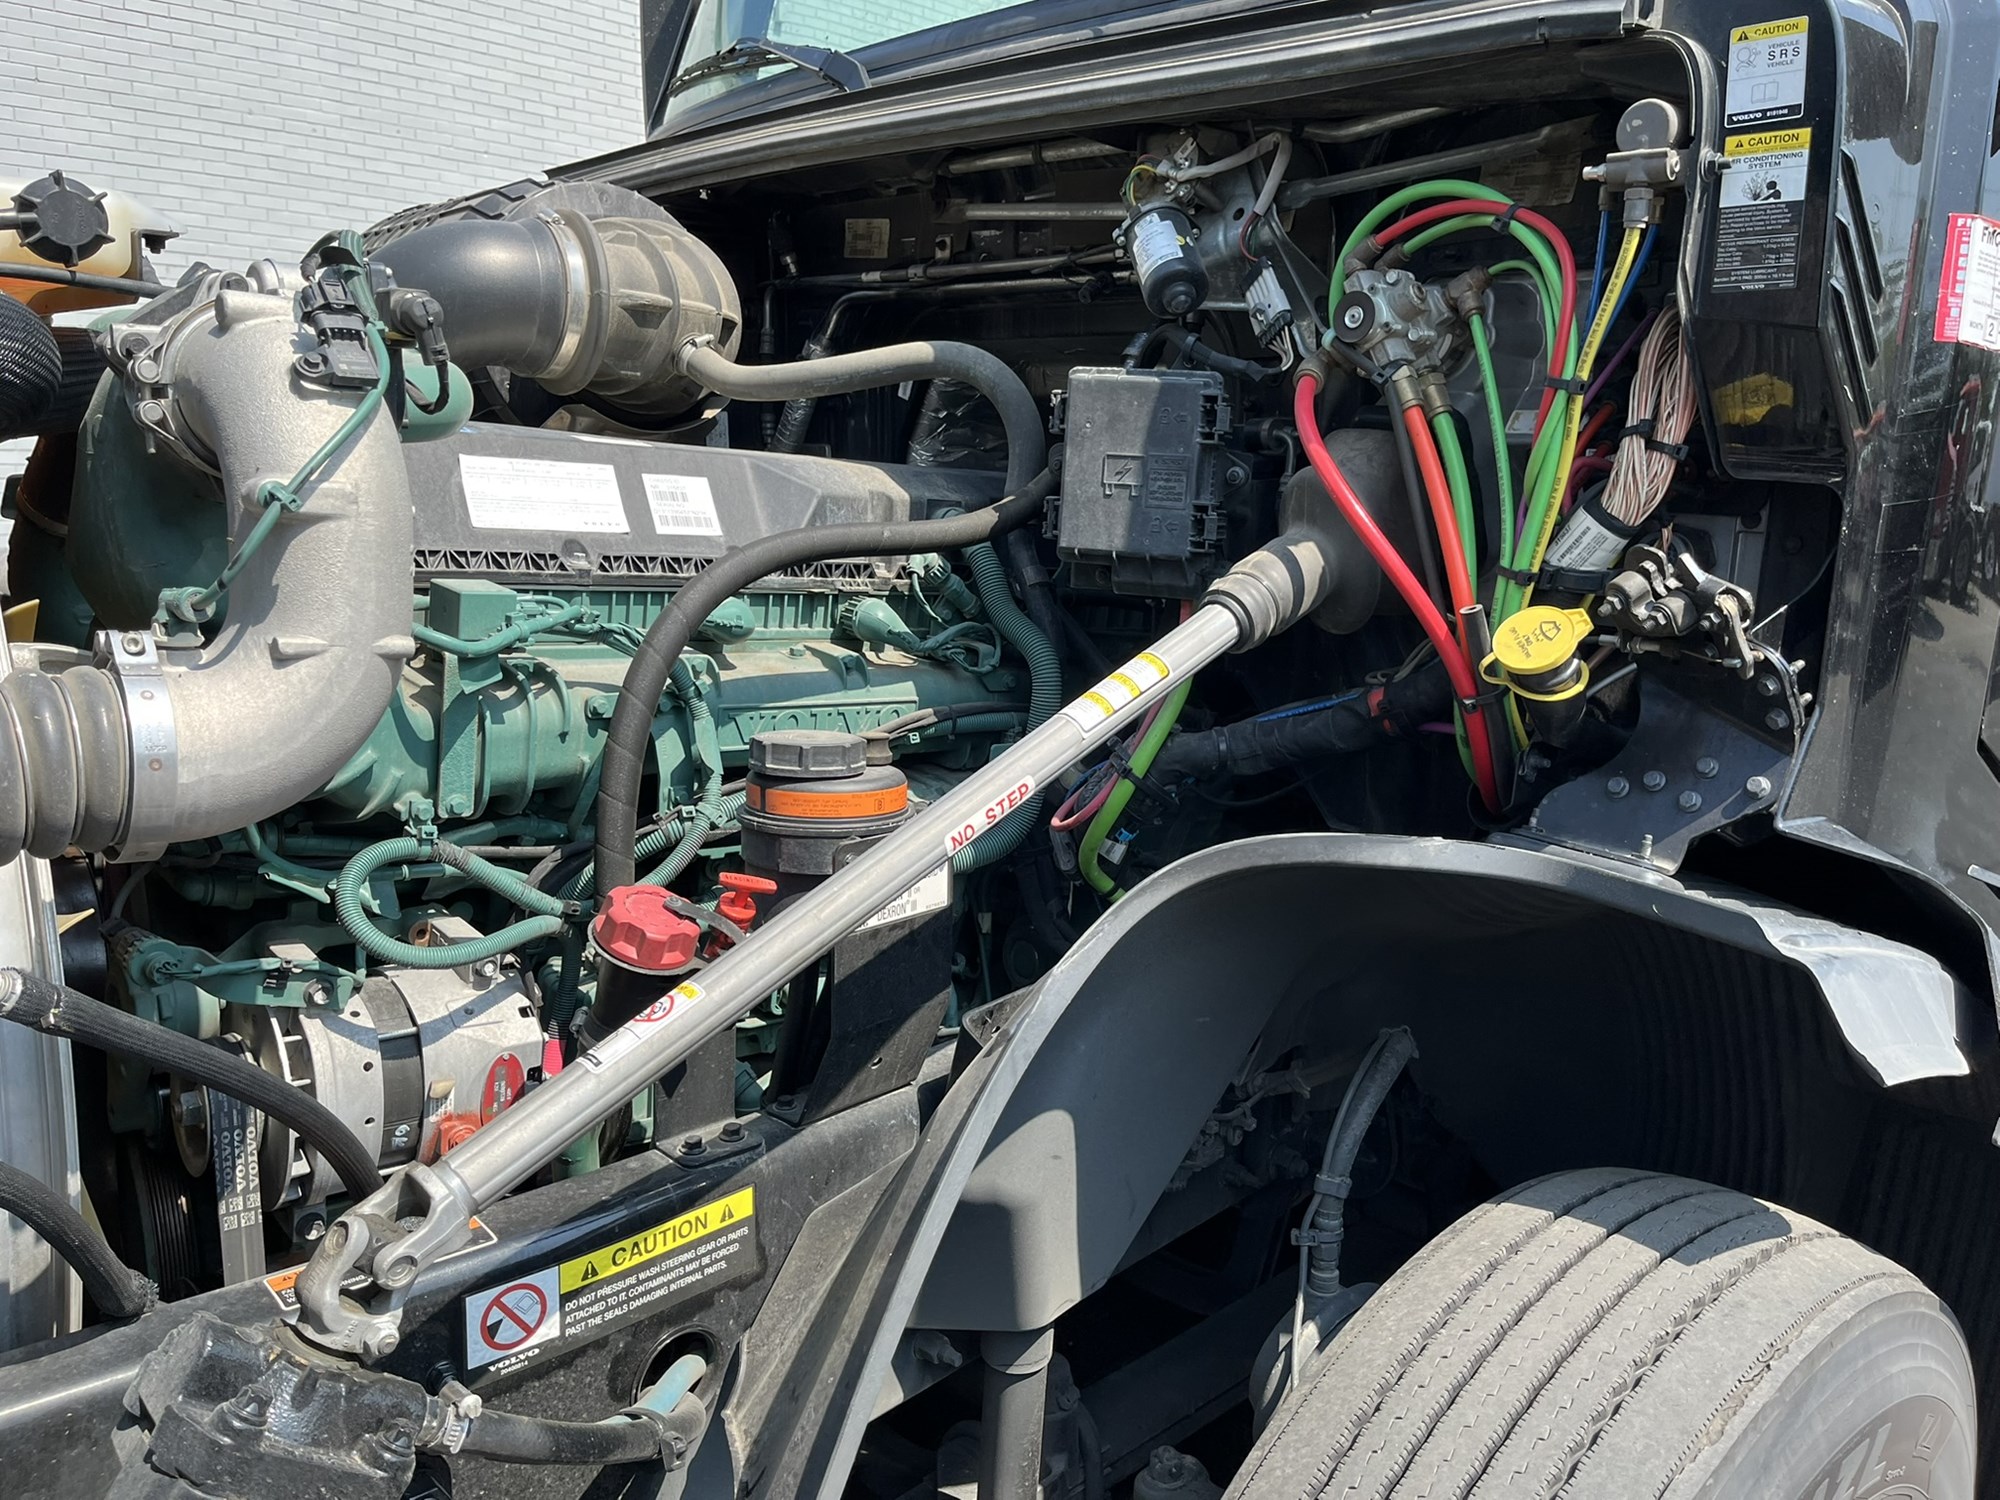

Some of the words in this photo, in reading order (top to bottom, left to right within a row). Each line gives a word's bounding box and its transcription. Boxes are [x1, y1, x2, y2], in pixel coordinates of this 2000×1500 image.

[1754, 23, 1798, 36] CAUTION
[1768, 40, 1800, 49] VEHICULE
[1767, 59, 1794, 68] VEHICLE
[1732, 112, 1762, 121] VOLVO
[1748, 133, 1799, 146] CAUTION
[1743, 152, 1803, 163] CONDITIONING
[1748, 161, 1781, 169] SYSTEM
[950, 824, 975, 850] NO
[985, 782, 1029, 826] STEP
[878, 902, 906, 921] DEXRON
[221, 1131, 233, 1196] VOLVO
[234, 1128, 246, 1193] VOLVO
[246, 1126, 259, 1190] VOLVO
[611, 1211, 708, 1267] CAUTION
[565, 1300, 578, 1312] DO
[579, 1293, 596, 1306] NOT
[597, 1277, 637, 1297] PRESSURE
[638, 1265, 660, 1280] WASH
[661, 1250, 696, 1271] STEERING
[697, 1241, 716, 1256] GEAR
[716, 1236, 727, 1247] OR
[728, 1227, 749, 1243] PARTS
[565, 1303, 606, 1324] ATTACHED
[607, 1297, 618, 1307] TO
[619, 1293, 627, 1302] IT.
[628, 1268, 684, 1297] CONTAMINANTS
[686, 1259, 700, 1273] MAY
[701, 1255, 711, 1265] BE
[712, 1243, 739, 1261] FORCED
[565, 1320, 586, 1337] PAST
[587, 1313, 603, 1328] THE
[604, 1304, 629, 1321] SEALS
[629, 1287, 669, 1310] DAMAGING
[669, 1272, 703, 1292] INTERNAL
[704, 1260, 728, 1276] PARTS.
[488, 1348, 540, 1371] VOLVO
